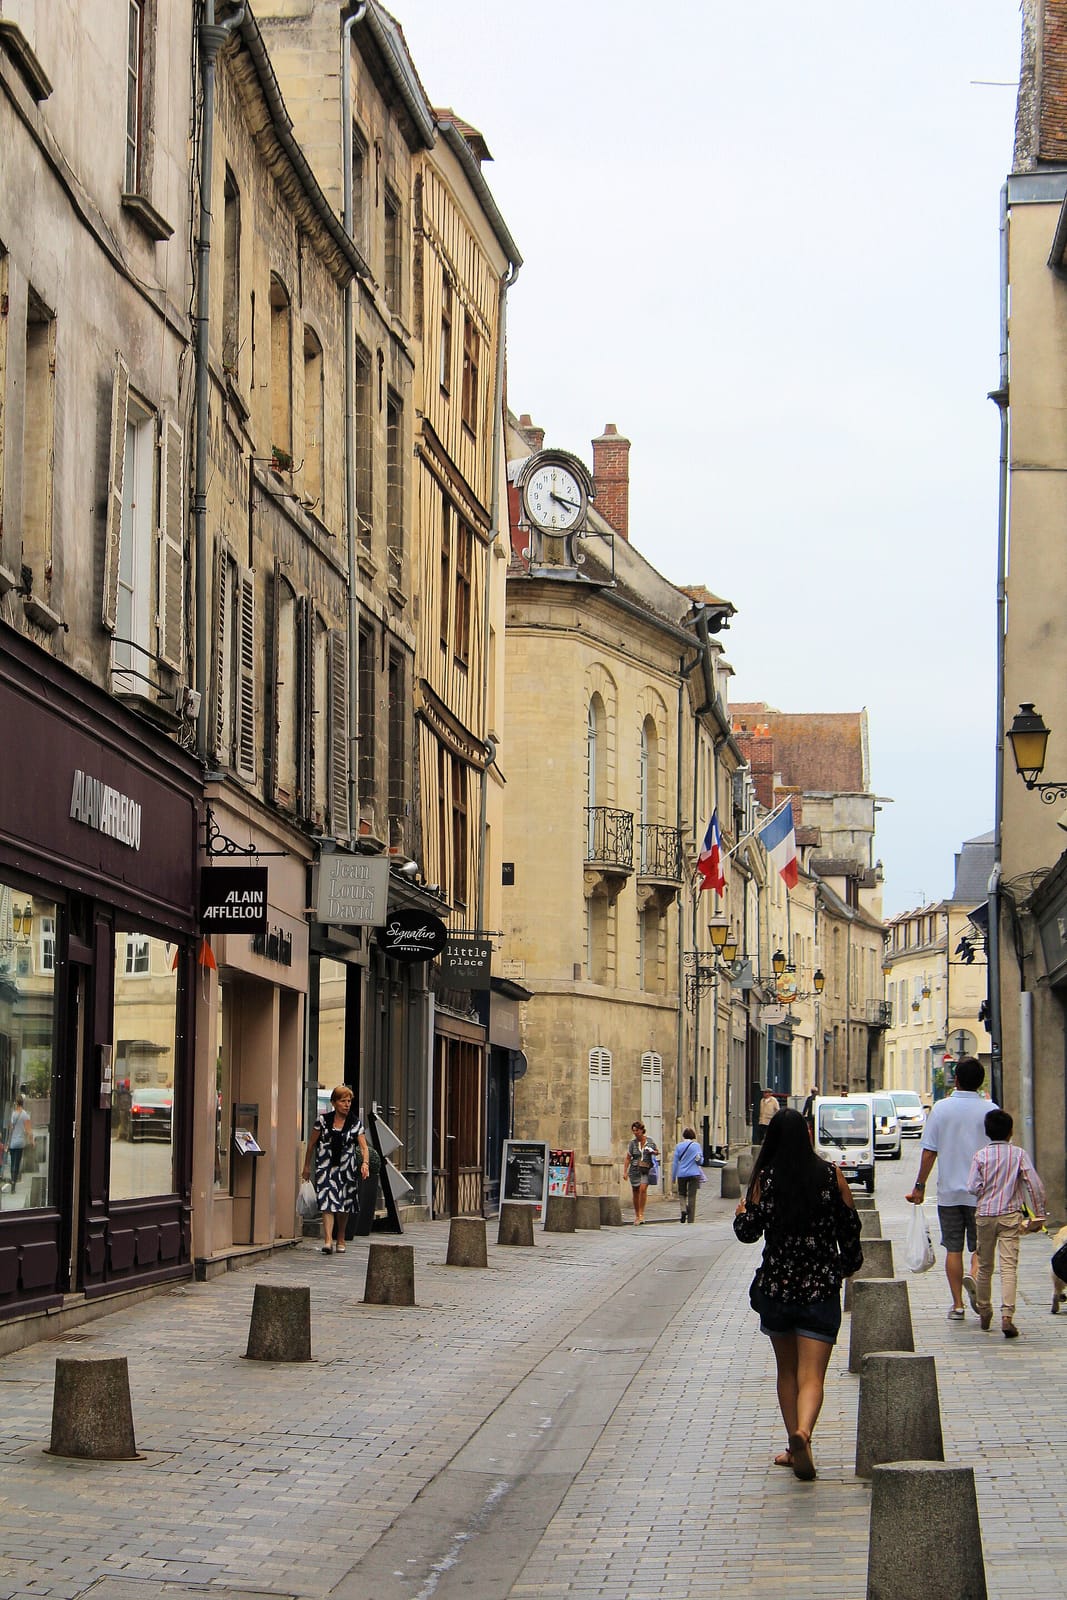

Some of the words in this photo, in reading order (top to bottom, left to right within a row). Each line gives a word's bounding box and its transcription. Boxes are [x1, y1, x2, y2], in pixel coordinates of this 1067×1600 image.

[550, 473, 557, 481] 12
[70, 769, 103, 829] ALAIN
[100, 784, 141, 851] AFFLELOU
[330, 859, 369, 879] Jean
[225, 891, 263, 903] ALAIN
[329, 879, 375, 899] Louis
[203, 906, 263, 919] AFFLELOU
[328, 899, 374, 920] David
[386, 921, 436, 944] Signature
[447, 946, 488, 958] little
[449, 958, 484, 967] place
